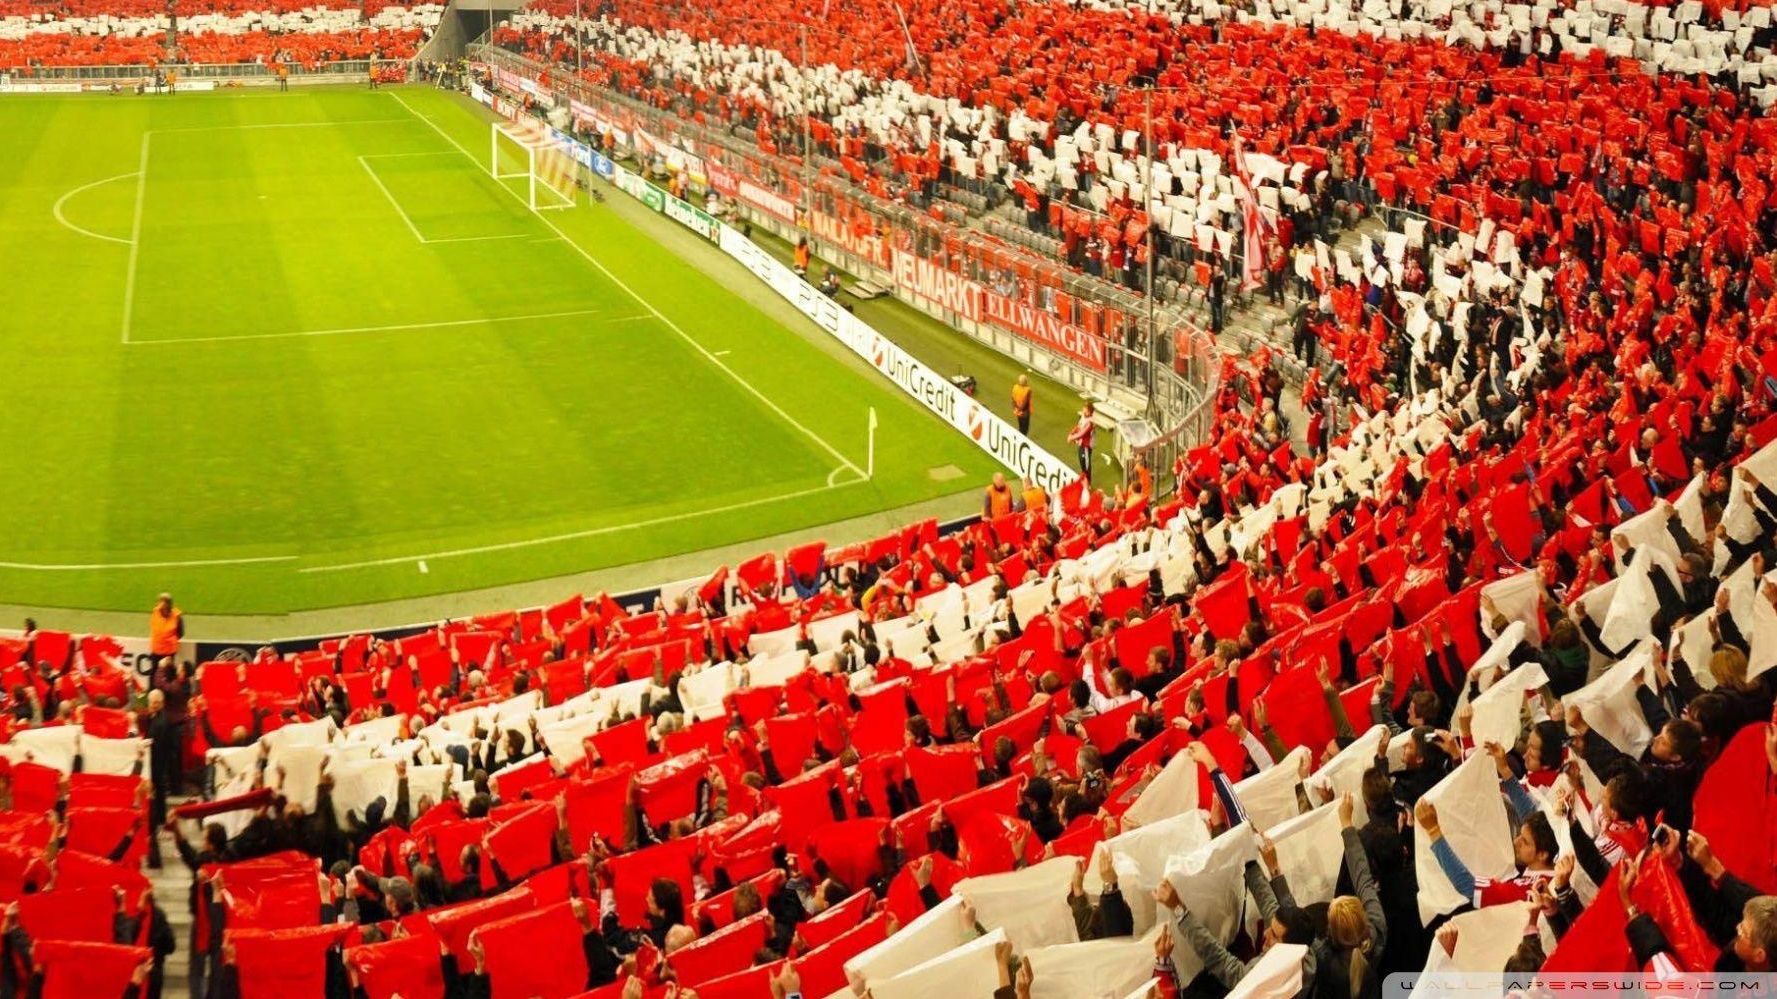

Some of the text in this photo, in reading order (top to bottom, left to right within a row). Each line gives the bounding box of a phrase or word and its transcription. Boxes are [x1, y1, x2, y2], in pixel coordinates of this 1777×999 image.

[891, 248, 982, 323] NEUMARKT
[987, 291, 1103, 366] ELLWANGEN
[887, 347, 956, 421] UniCredit
